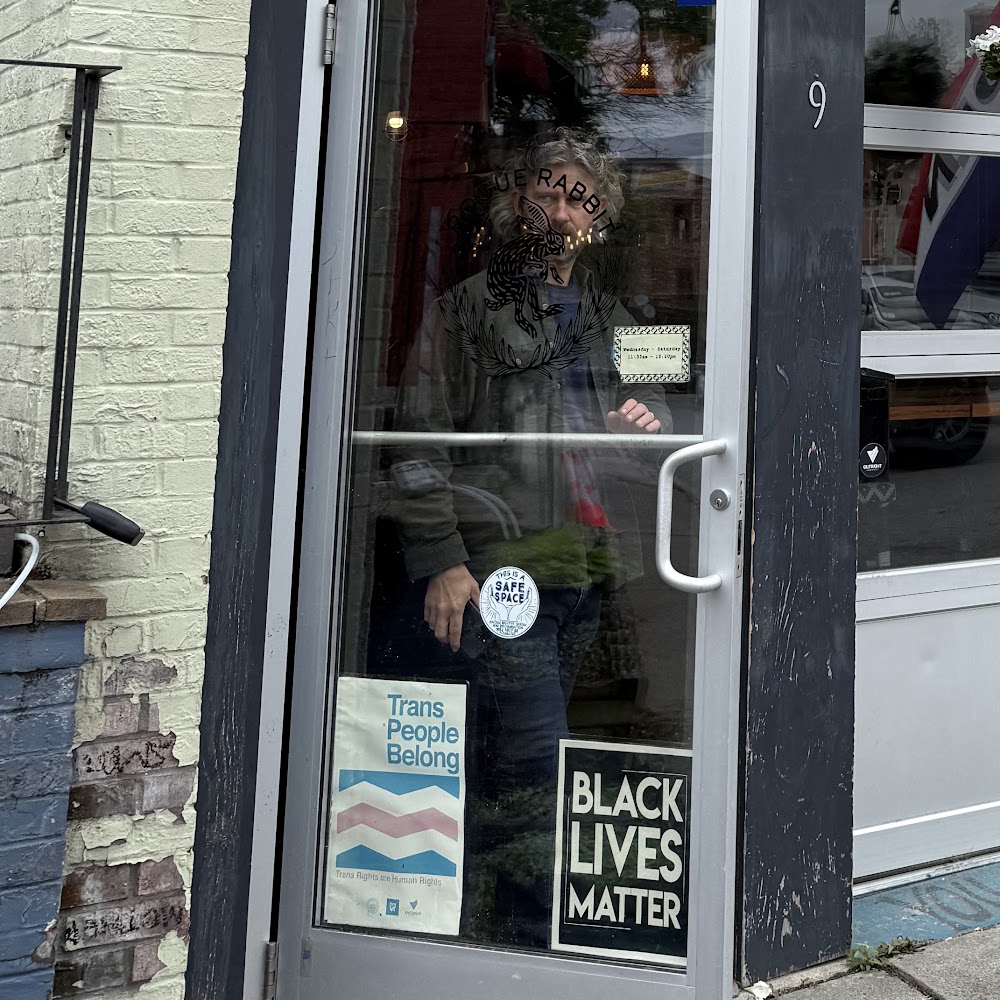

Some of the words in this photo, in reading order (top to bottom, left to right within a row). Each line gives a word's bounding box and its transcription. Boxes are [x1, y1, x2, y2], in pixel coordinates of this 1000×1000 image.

[809, 81, 826, 128] 9
[536, 167, 617, 234] RABBIT
[495, 581, 525, 593] SAFE
[512, 570, 519, 578] IS
[494, 592, 525, 604] SPACE
[387, 694, 444, 718] Trans
[387, 719, 459, 747] People
[387, 743, 460, 774] Belong
[571, 771, 684, 823] BLACK
[570, 821, 683, 883] LIVES
[335, 869, 355, 879] Trans
[356, 871, 379, 881] Rights
[391, 874, 418, 884] Human
[419, 876, 442, 887] Rights
[568, 882, 682, 930] MATTER
